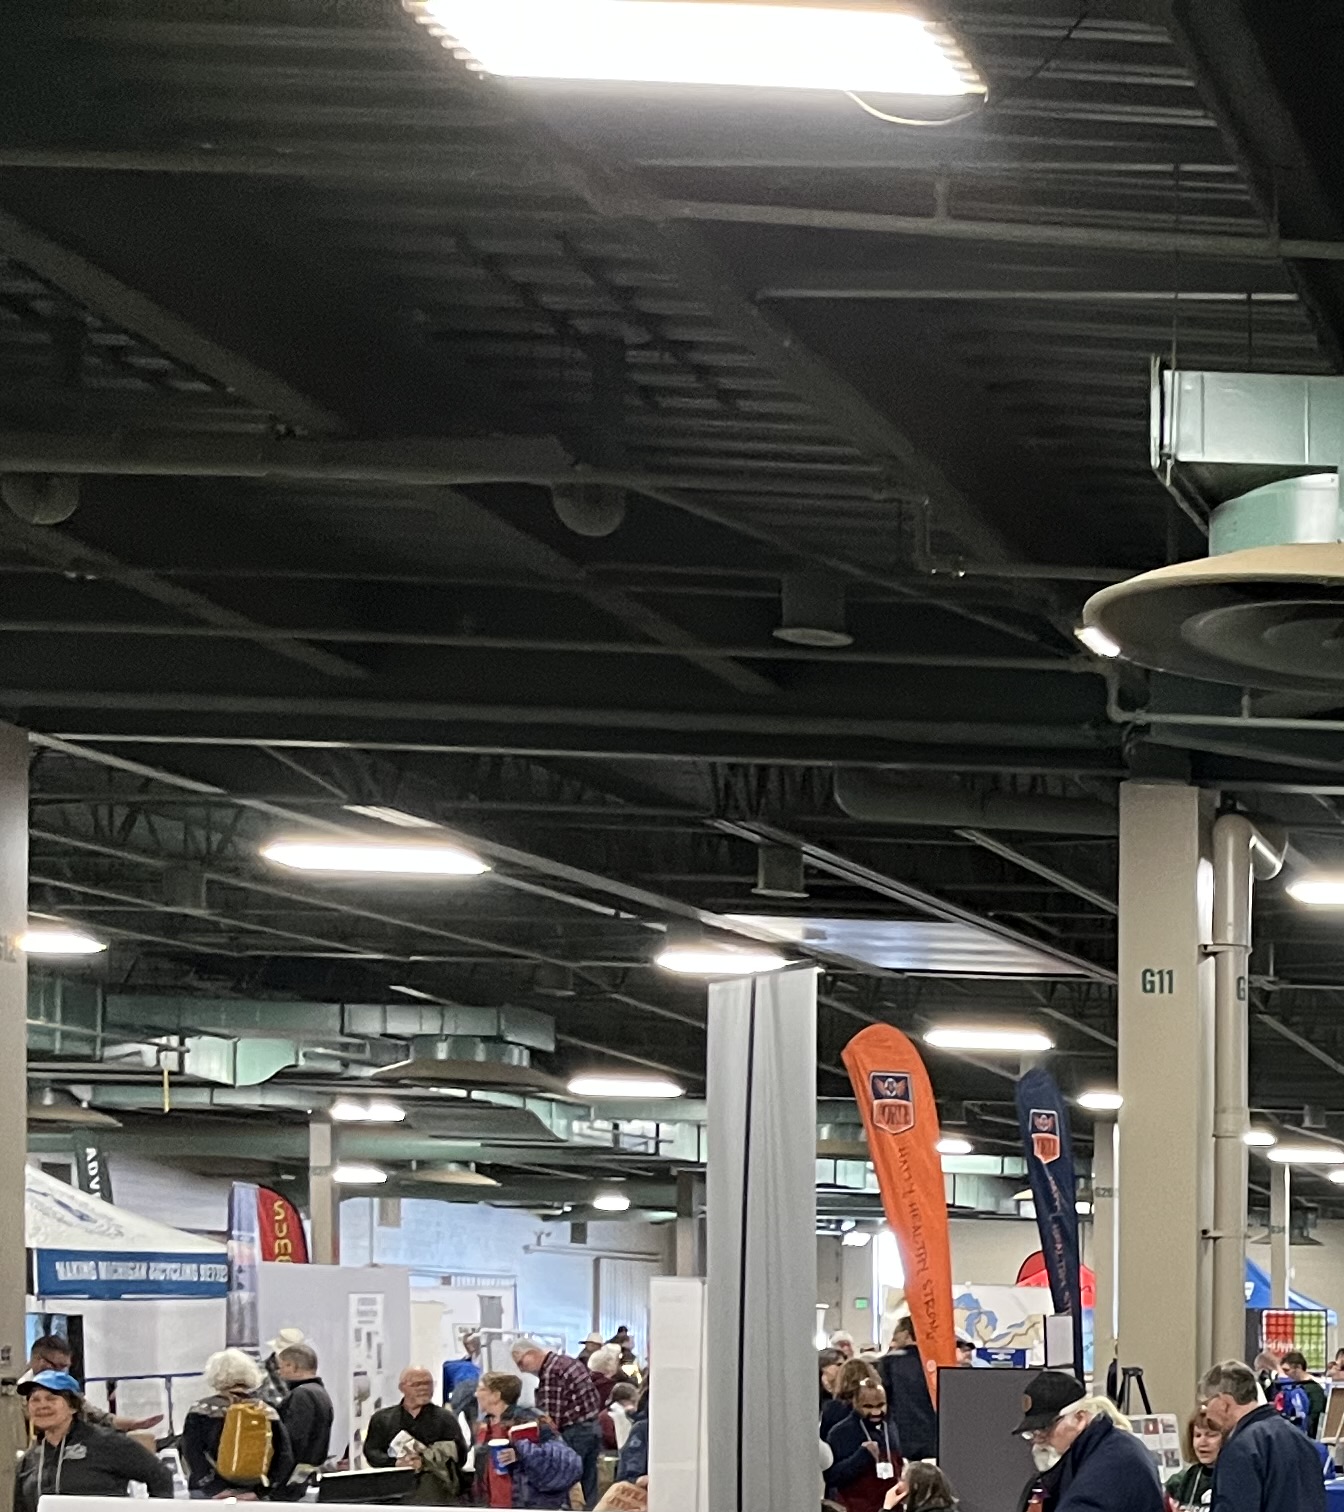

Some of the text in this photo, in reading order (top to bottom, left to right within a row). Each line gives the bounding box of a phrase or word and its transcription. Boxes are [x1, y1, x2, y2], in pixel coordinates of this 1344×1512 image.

[1141, 968, 1174, 994] G11
[85, 1147, 102, 1197] ADV
[273, 1200, 292, 1262] SUM
